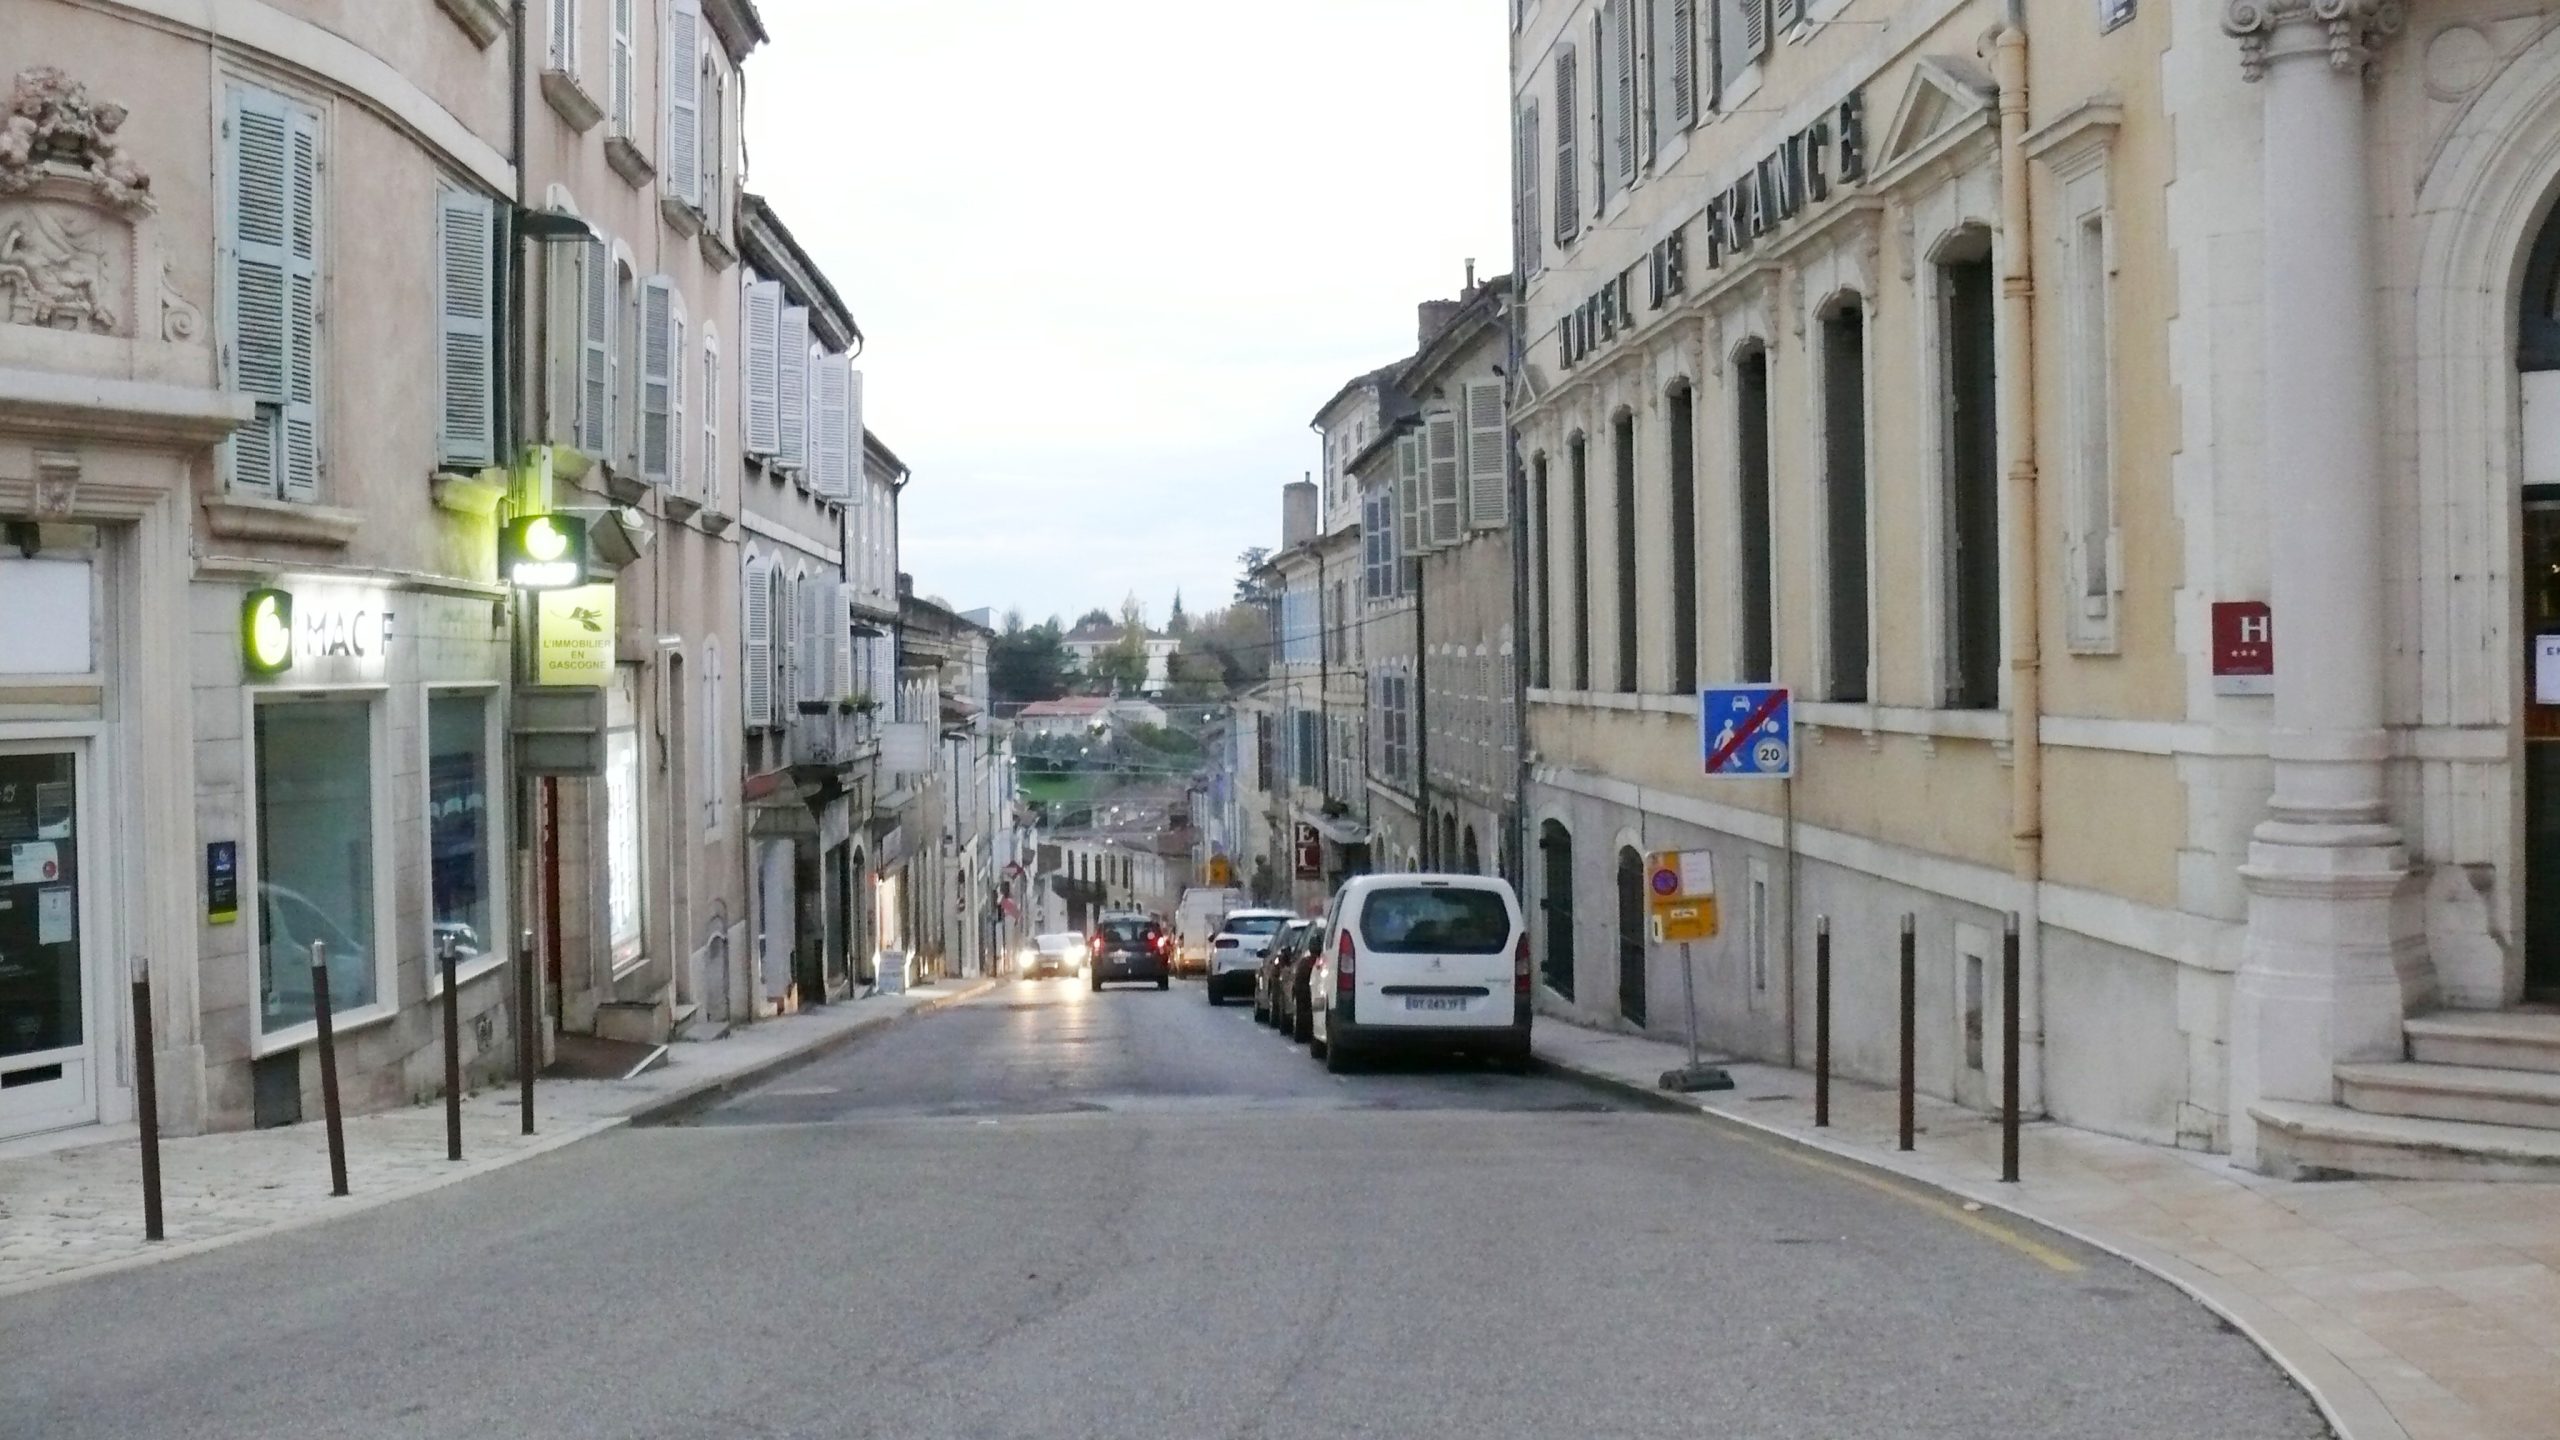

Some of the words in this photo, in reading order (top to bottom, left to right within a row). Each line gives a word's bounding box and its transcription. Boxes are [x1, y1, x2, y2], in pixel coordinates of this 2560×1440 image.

[1557, 272, 1633, 370] HOTEL
[1647, 230, 1684, 310] DE
[1706, 91, 1863, 270] FRANCE
[306, 610, 395, 657] MACF
[2241, 616, 2267, 643] H
[543, 639, 611, 649] L'IMMOBILIER
[571, 650, 585, 659] EN
[548, 660, 607, 670] GASCOGNE
[1760, 748, 1780, 761] 20
